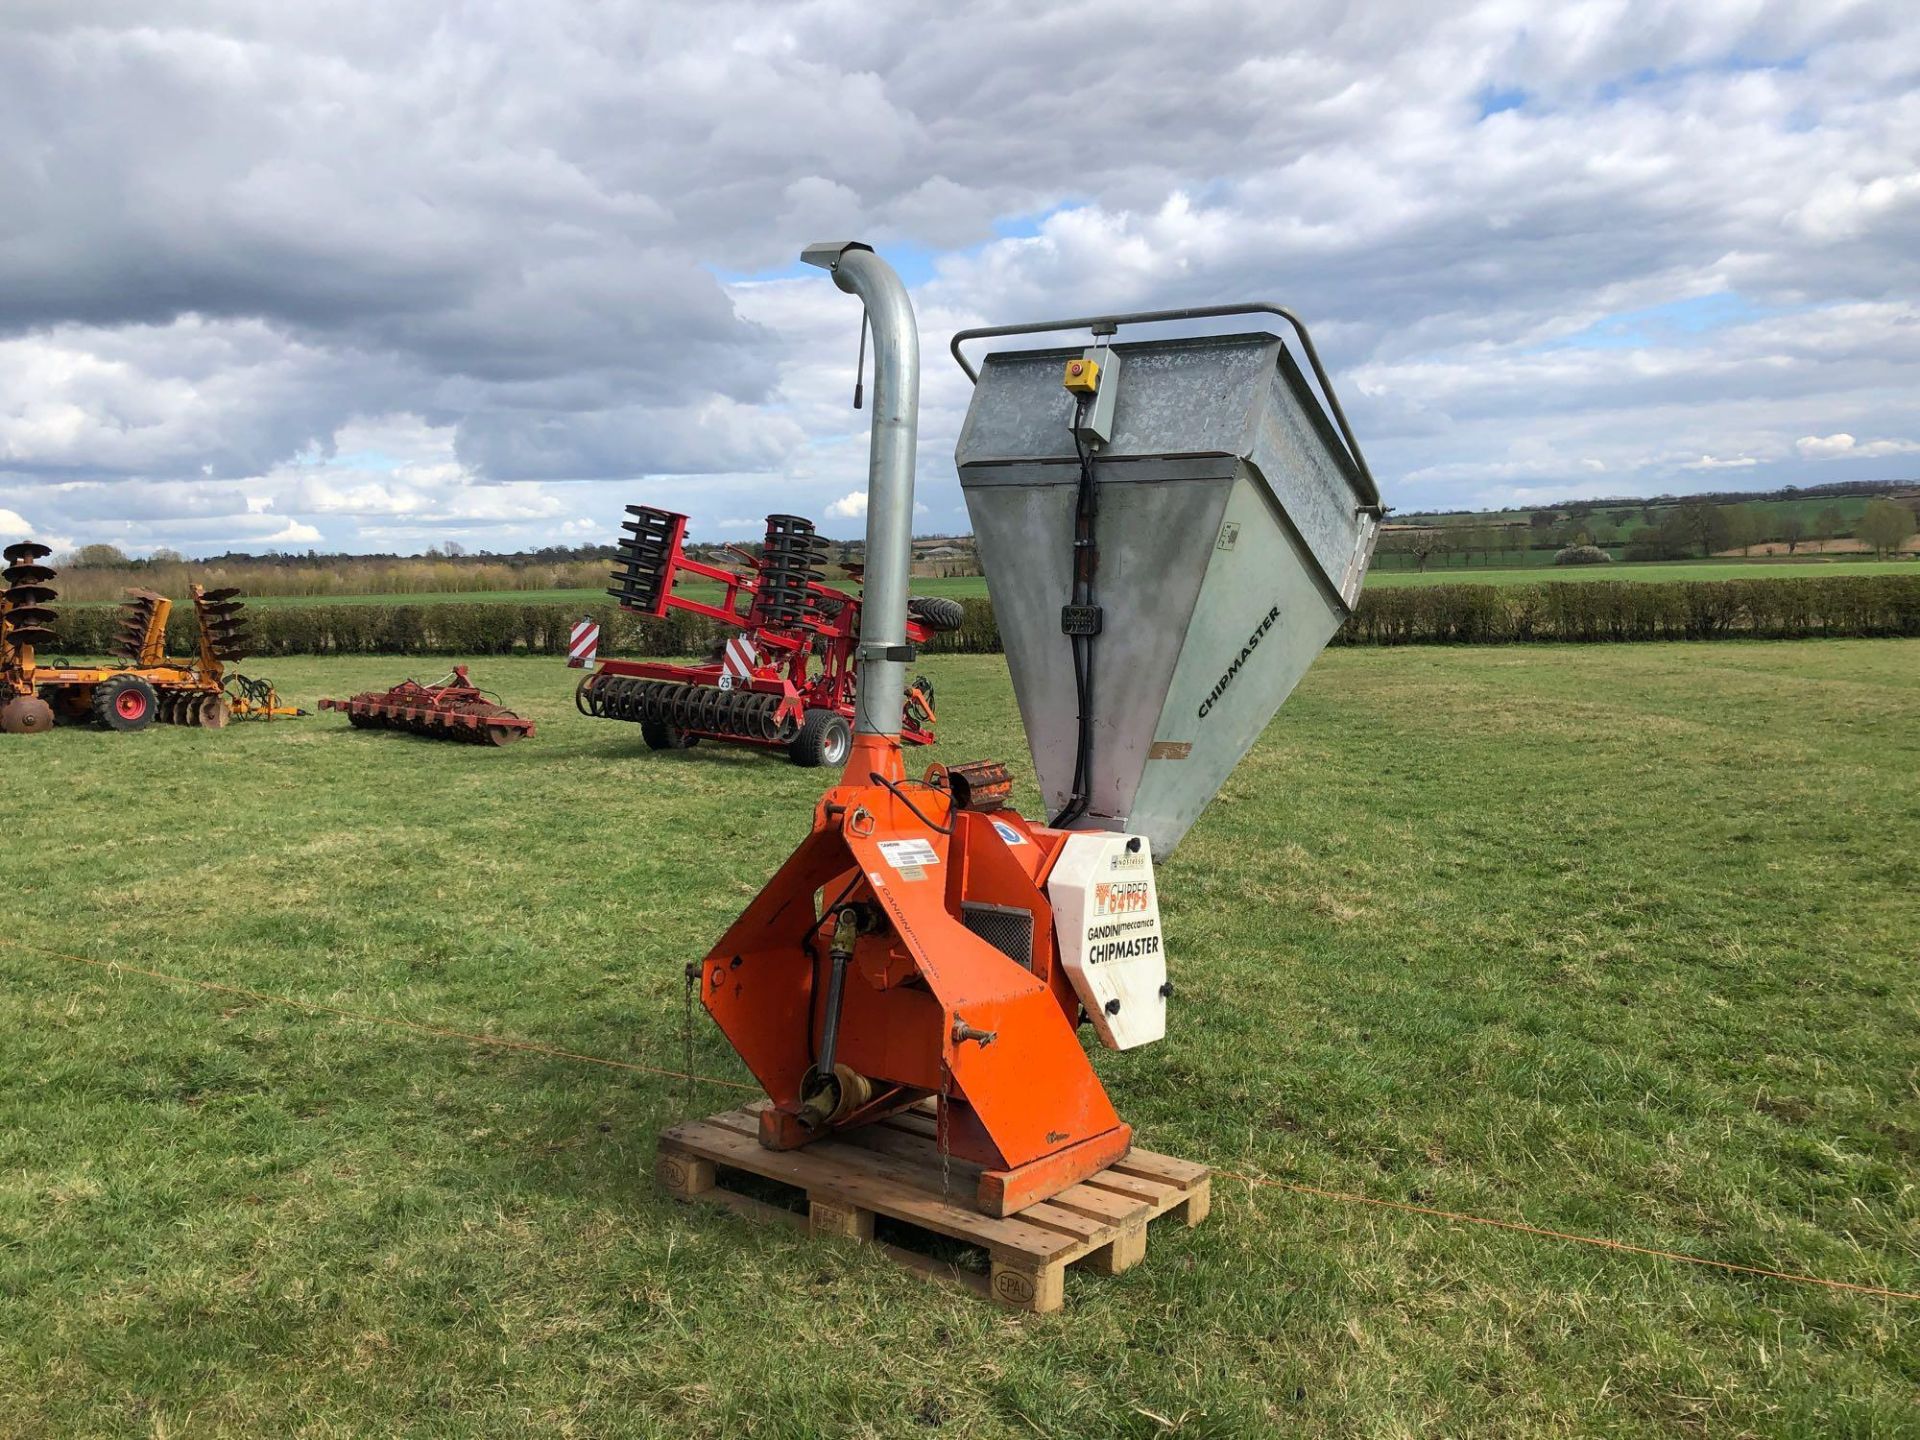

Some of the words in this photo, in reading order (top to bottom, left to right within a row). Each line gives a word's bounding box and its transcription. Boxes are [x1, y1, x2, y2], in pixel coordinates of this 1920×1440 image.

[1198, 606, 1280, 719] CHIPMASTER
[720, 677, 730, 688] 25
[1089, 936, 1159, 965] CHIPMASTER
[1000, 1275, 1029, 1299] EPAL
